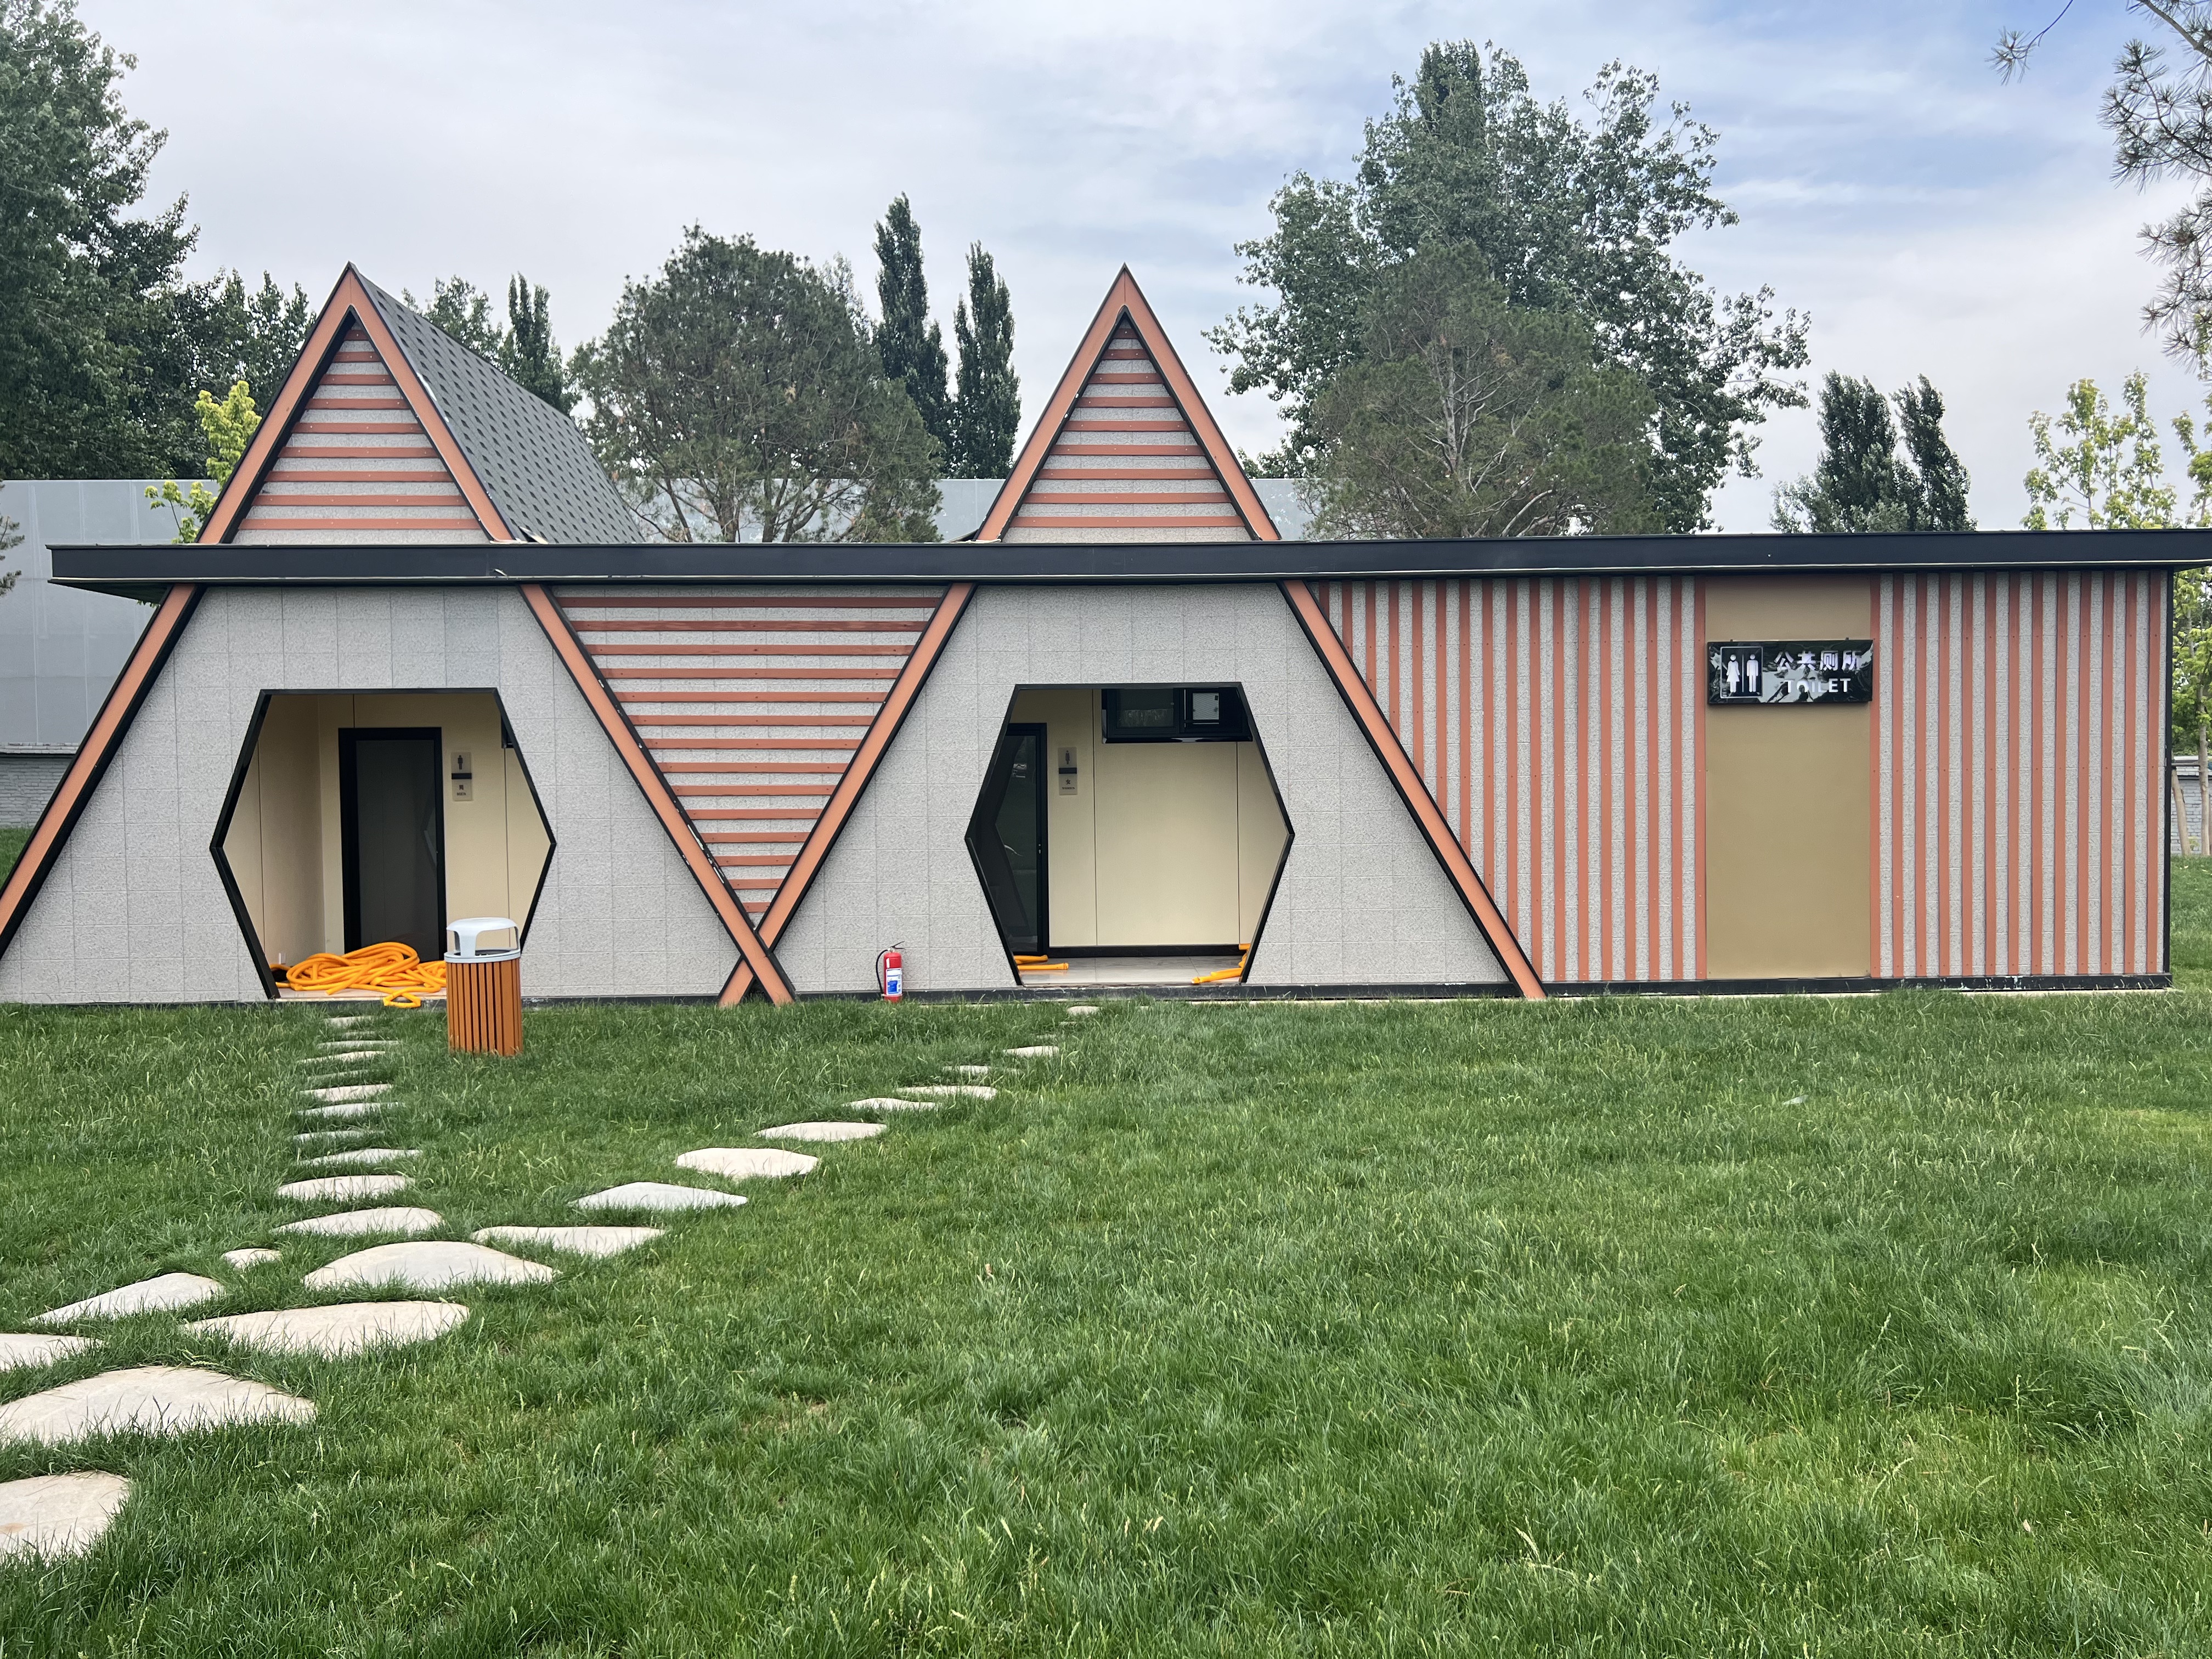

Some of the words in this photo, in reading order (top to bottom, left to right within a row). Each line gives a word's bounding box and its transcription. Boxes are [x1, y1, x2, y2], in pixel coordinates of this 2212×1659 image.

[1774, 650, 1862, 671] 公共厕所
[1784, 678, 1851, 693] TOILET
